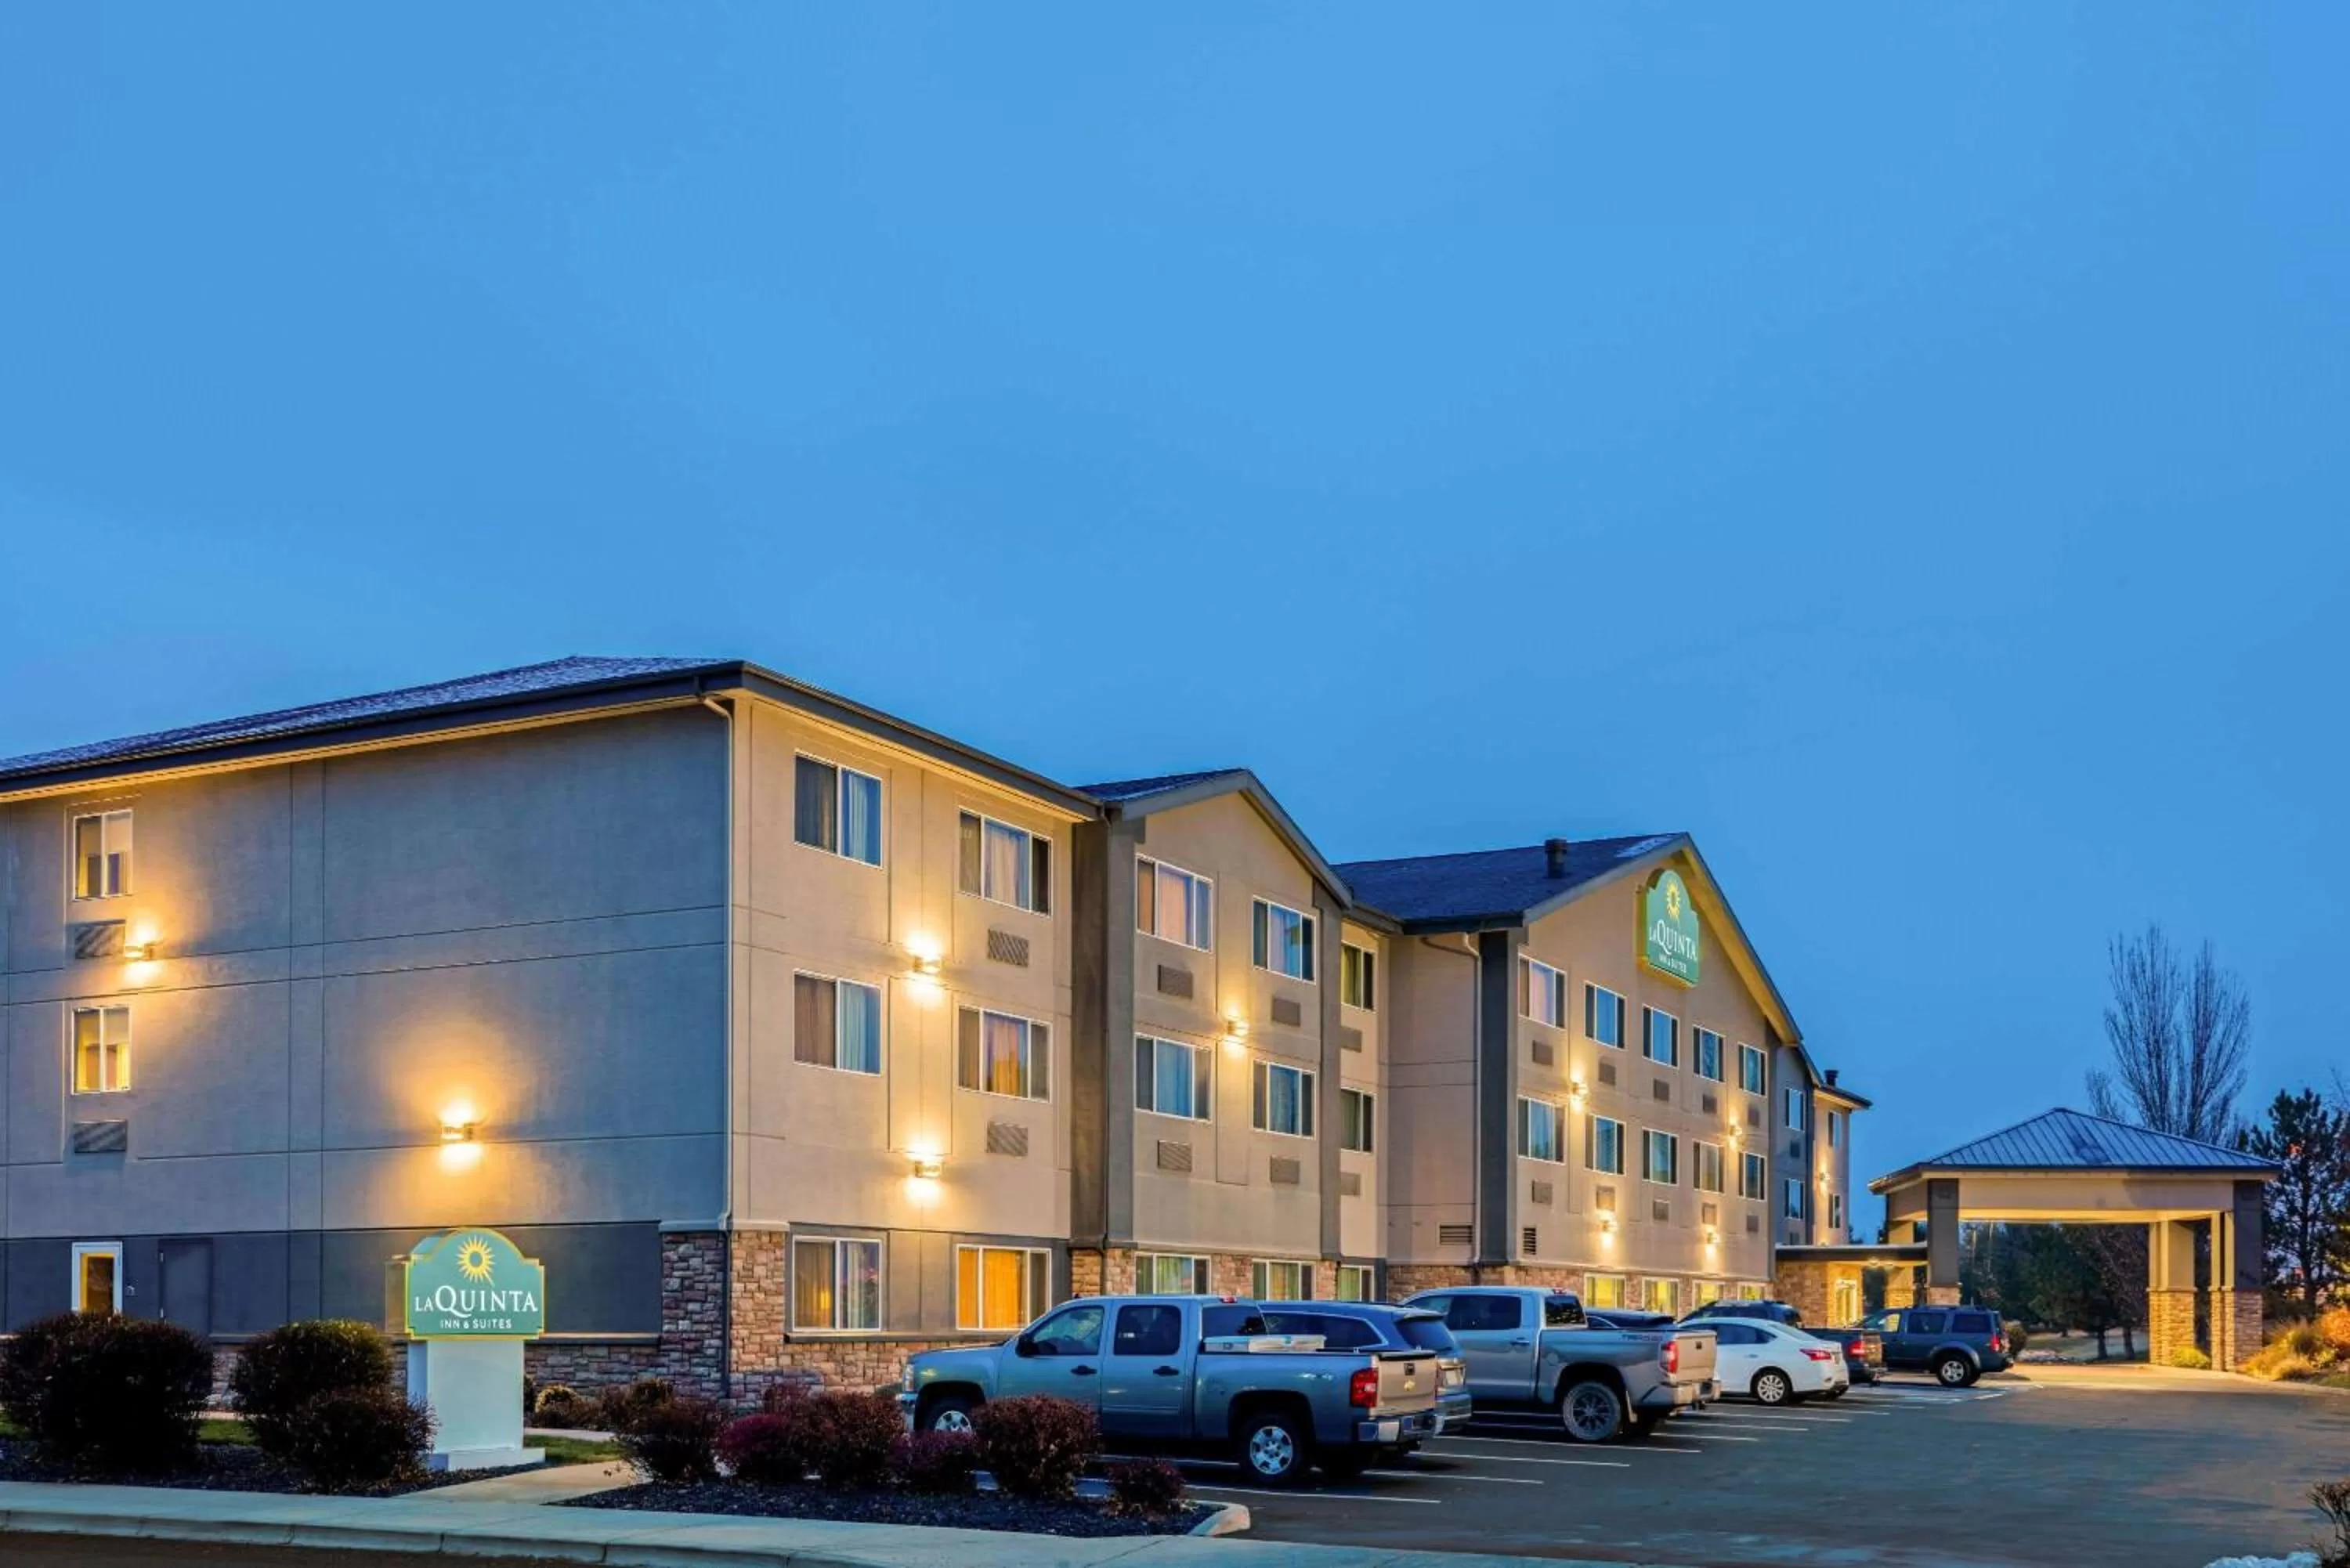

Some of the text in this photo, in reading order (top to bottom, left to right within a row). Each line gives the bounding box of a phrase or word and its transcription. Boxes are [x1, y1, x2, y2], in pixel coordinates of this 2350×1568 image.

[1657, 919, 1698, 962] QUINTA
[414, 1284, 538, 1318] LA QUINTA
[439, 1319, 461, 1329] INN
[472, 1318, 512, 1329] SUITES
